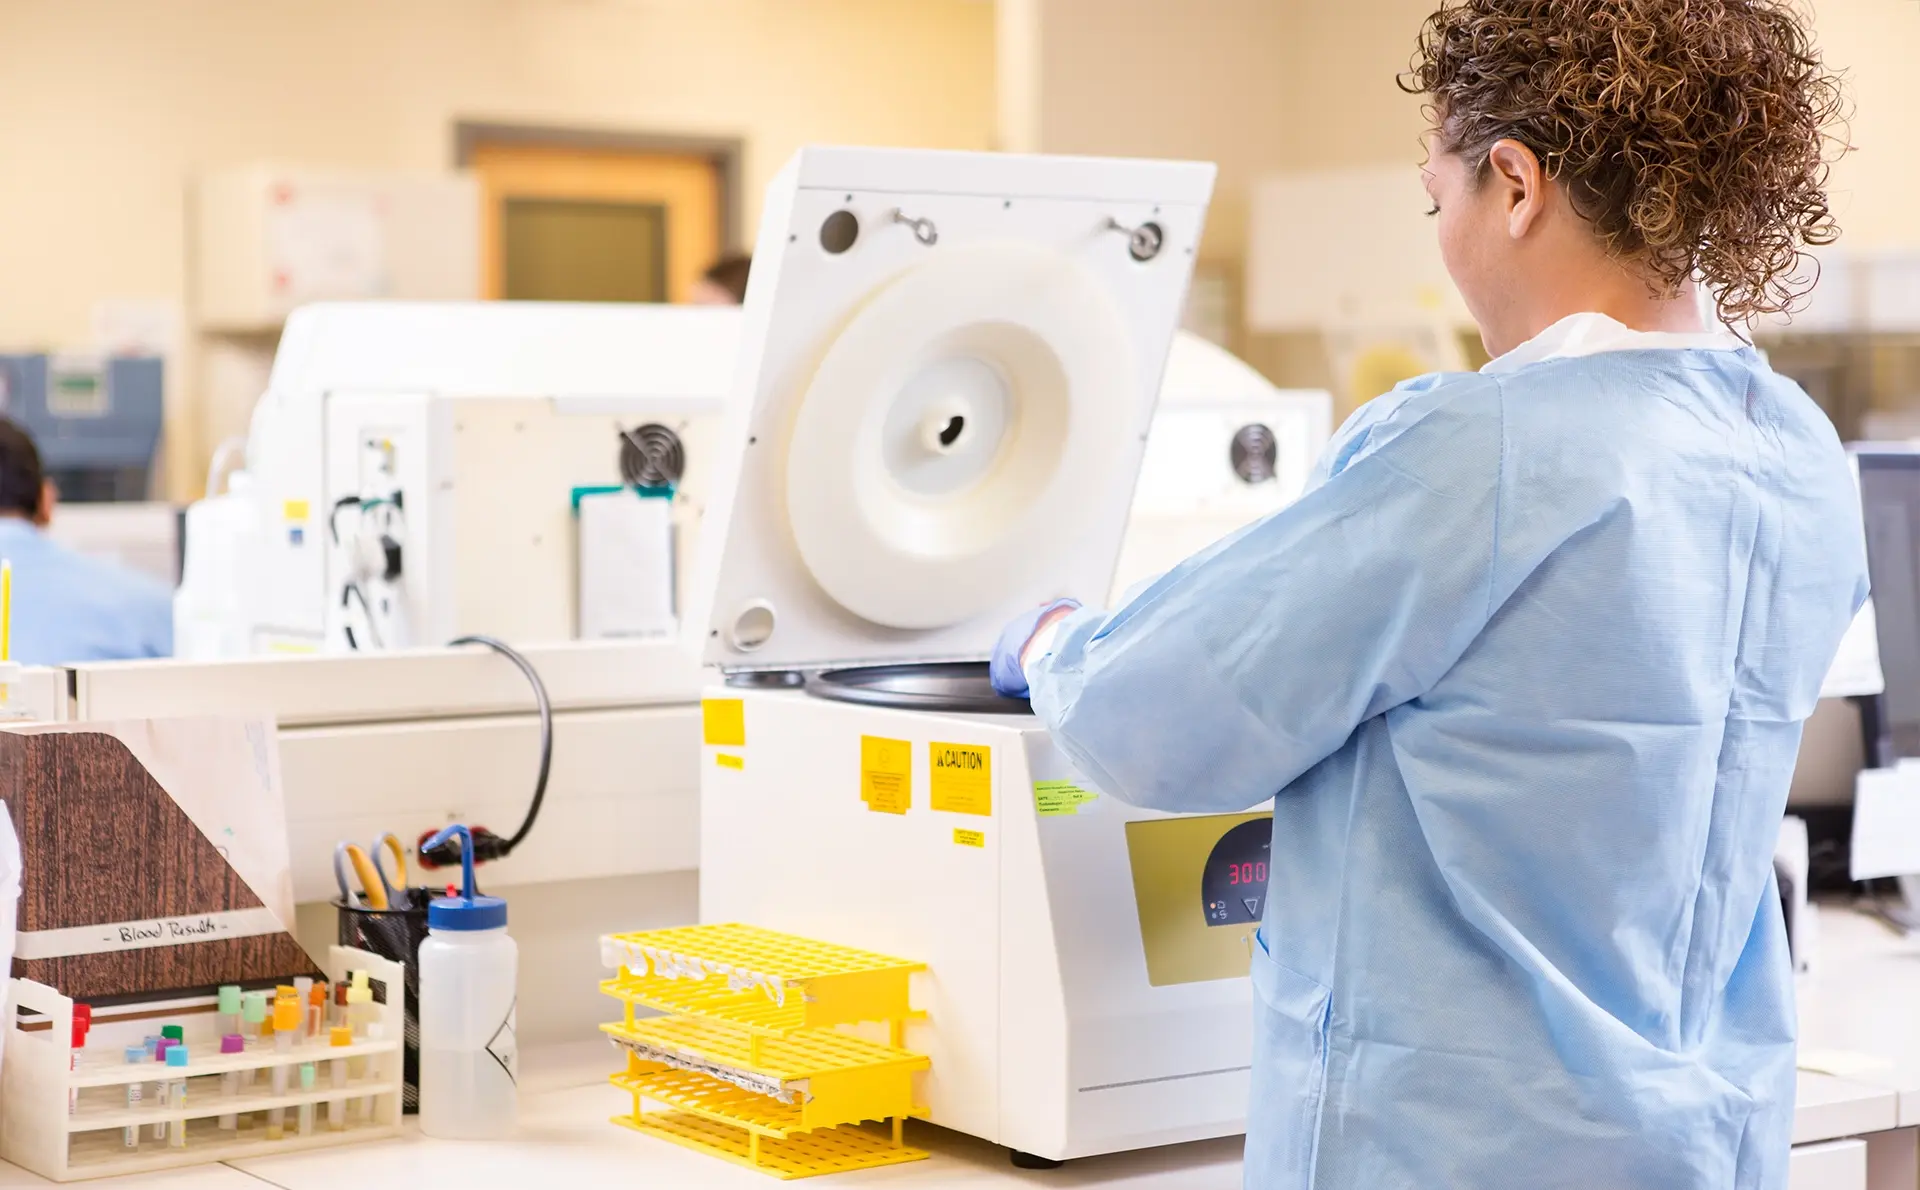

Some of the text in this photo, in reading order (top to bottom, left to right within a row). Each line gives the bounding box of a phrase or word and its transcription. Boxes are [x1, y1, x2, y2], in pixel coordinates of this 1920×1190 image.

[945, 750, 982, 770] CAUTION
[1229, 862, 1266, 885] 300
[119, 922, 162, 942] Blood
[167, 918, 216, 938] Results
